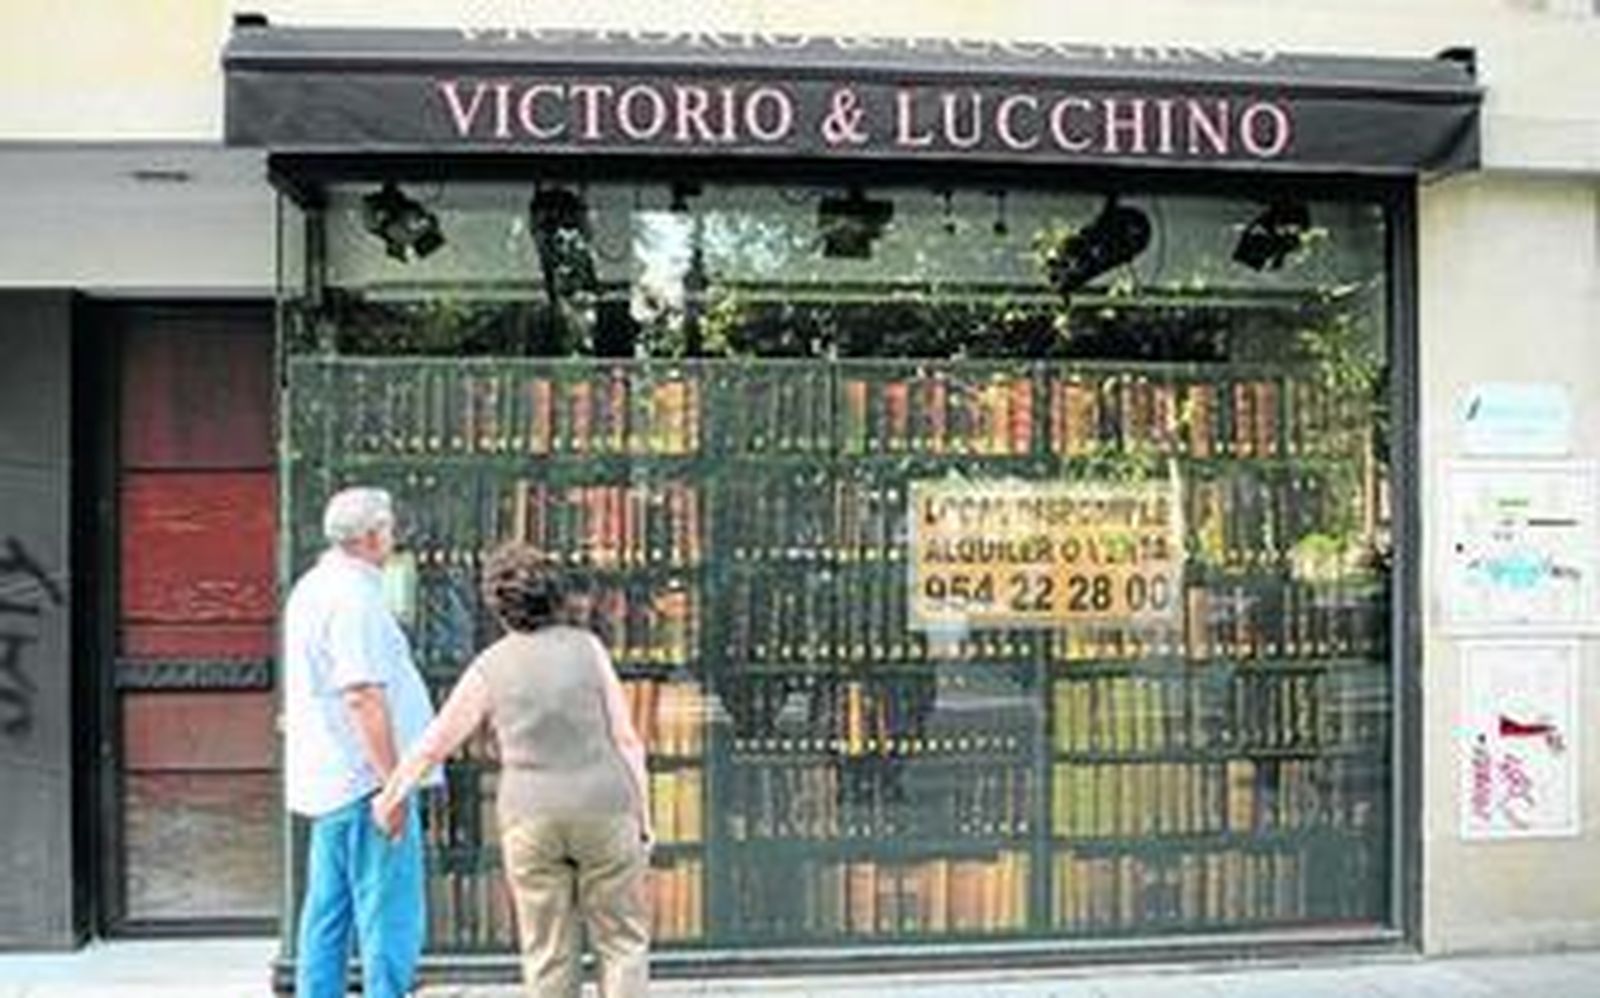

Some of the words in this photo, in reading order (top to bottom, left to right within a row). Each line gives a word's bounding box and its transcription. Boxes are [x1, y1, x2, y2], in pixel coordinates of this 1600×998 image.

[437, 80, 793, 142] VICTORIO
[821, 87, 870, 145] &
[896, 92, 1291, 157] LUCCHINO
[924, 536, 1055, 563] ALQUILER
[925, 573, 995, 610] 954
[1009, 574, 1054, 611] 22
[1068, 574, 1112, 611] 28
[1126, 574, 1169, 611] 00
